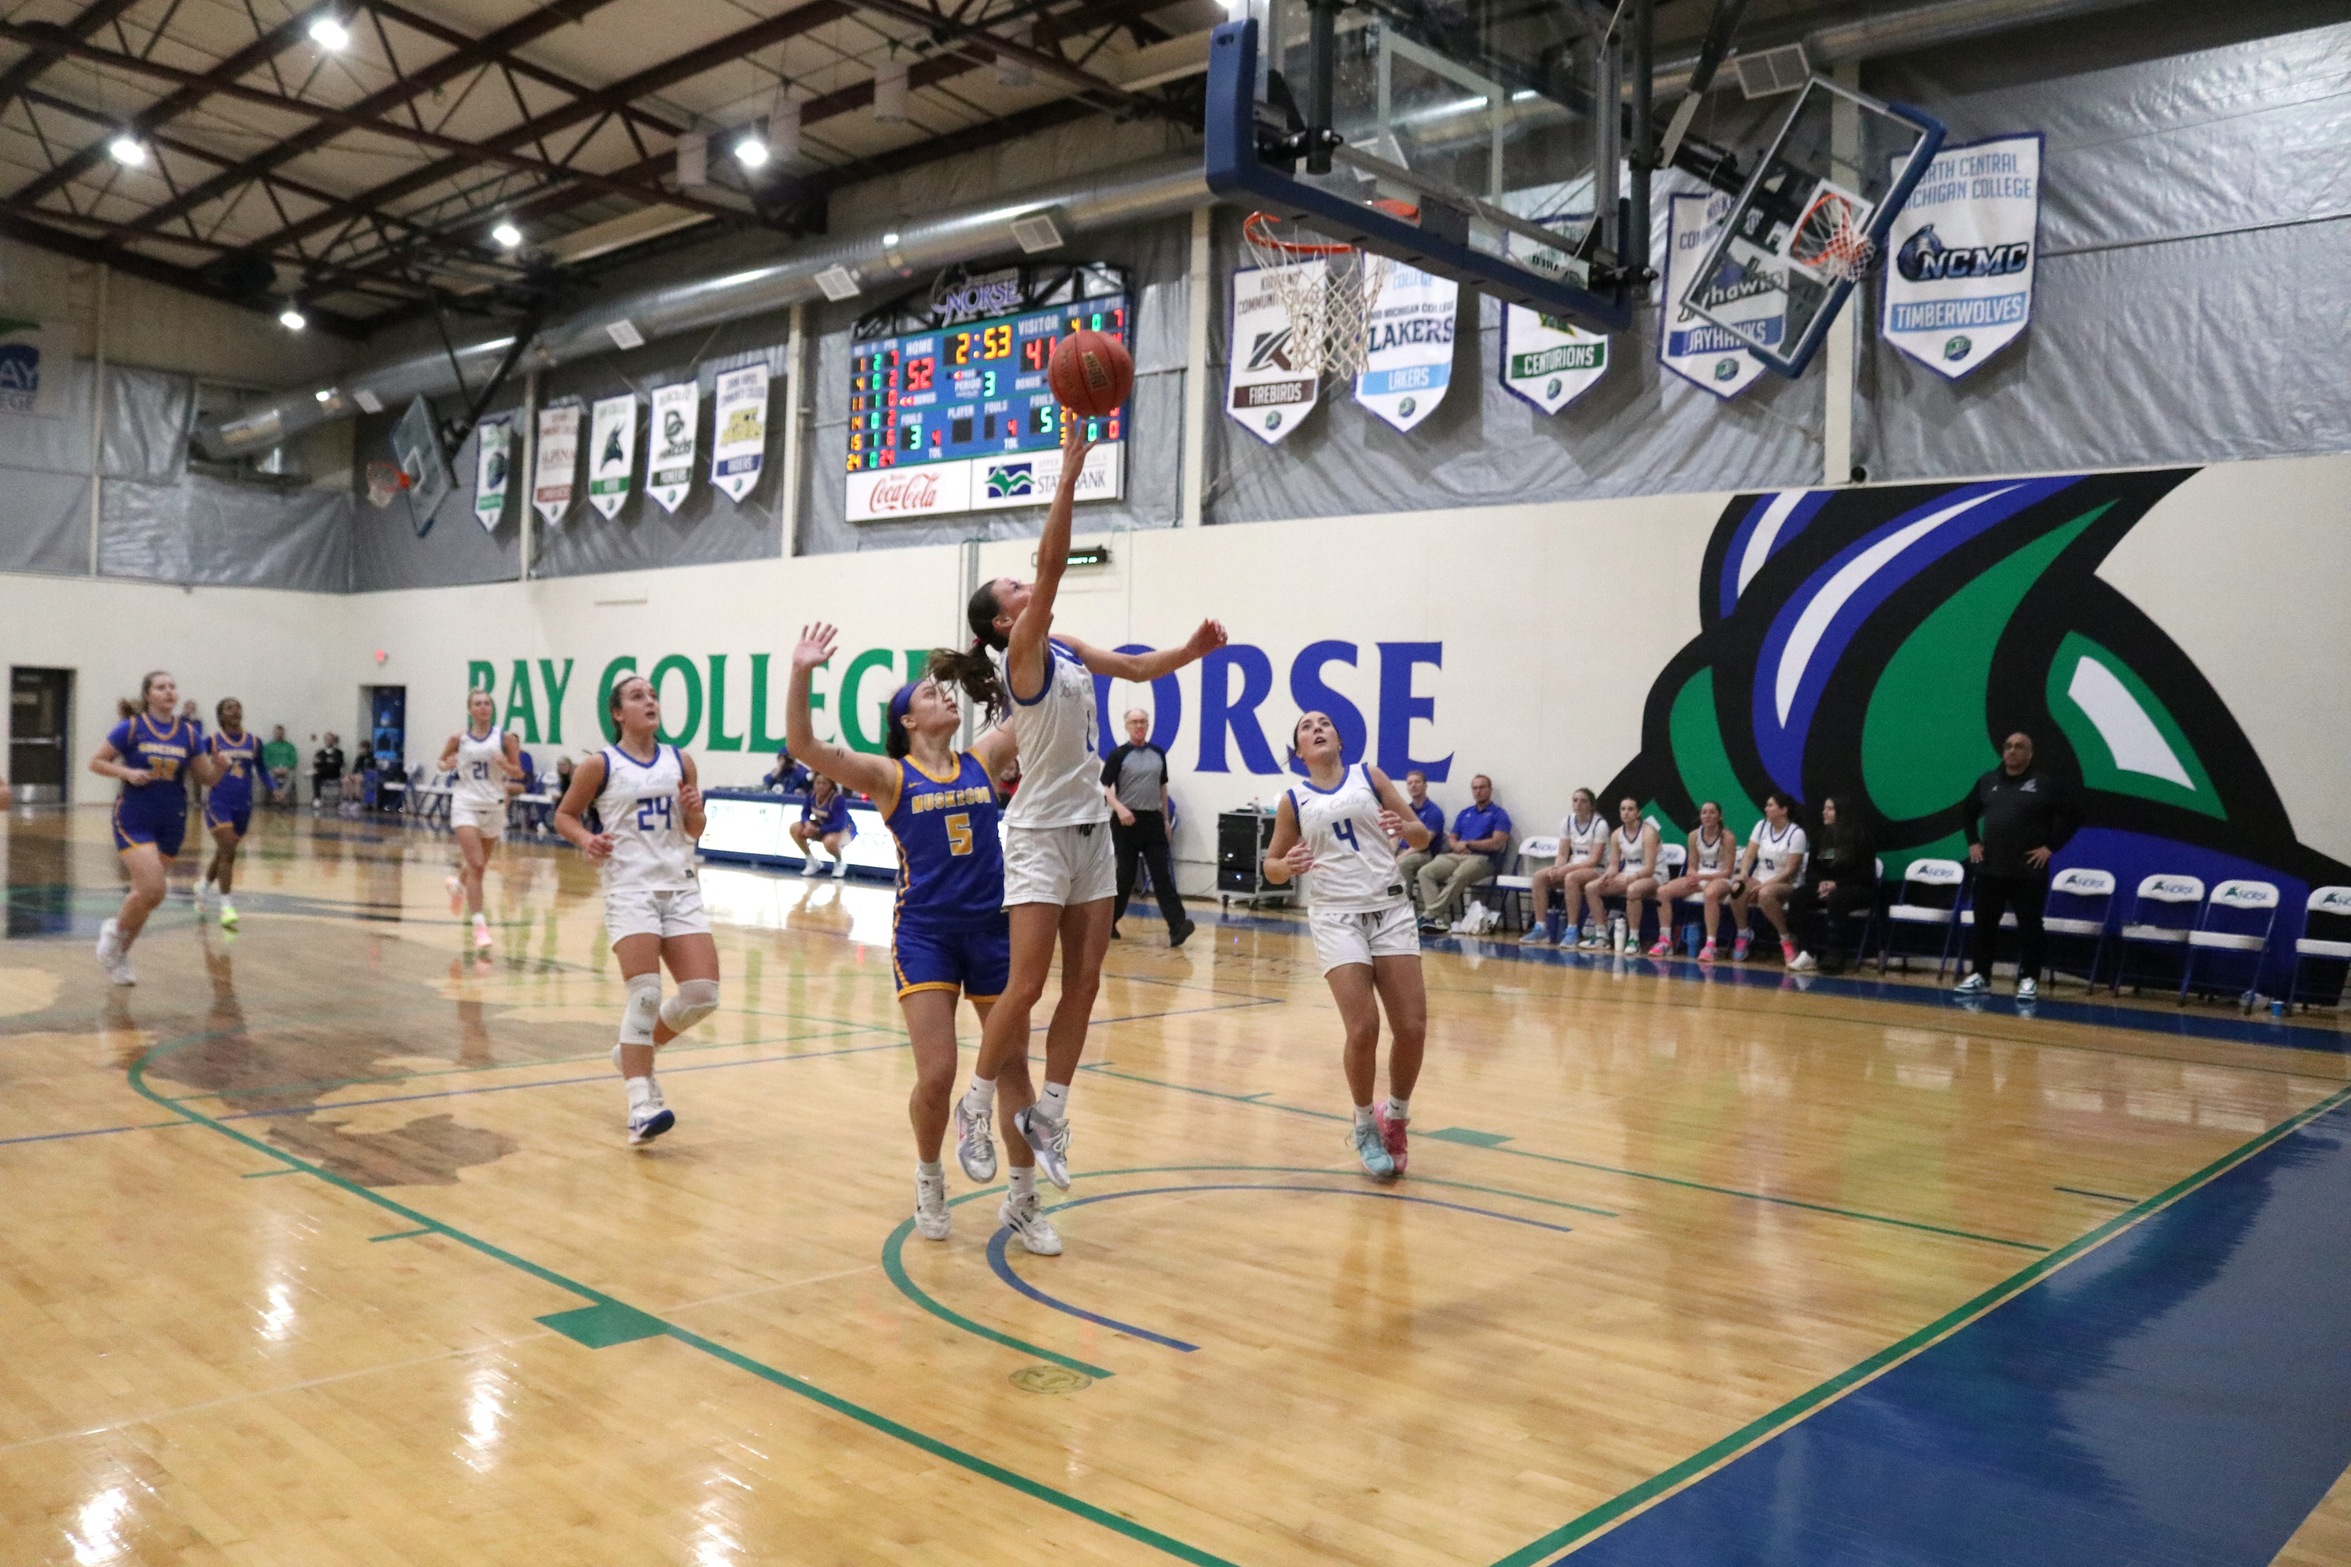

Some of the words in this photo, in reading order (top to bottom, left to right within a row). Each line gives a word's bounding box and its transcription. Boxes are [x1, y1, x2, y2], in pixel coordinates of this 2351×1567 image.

[1920, 160, 1955, 185] RTH
[1959, 153, 2020, 178] CENTRAL
[1972, 177, 2031, 200] COLLEGE
[1918, 241, 2030, 281] NCMC
[930, 278, 1024, 329] NORSE
[1896, 294, 2022, 329] TIMBERWOLVES
[1018, 314, 1059, 336] VISITOR
[1091, 313, 1102, 332] 0
[1368, 315, 1454, 353] LAKERS
[905, 337, 935, 357] HOME
[955, 324, 1013, 365] 2:53
[873, 353, 883, 371] 2
[907, 357, 935, 391] 52
[1523, 345, 1595, 376] CENTURIONS
[0, 359, 34, 391] AY
[983, 370, 997, 397] 3
[1387, 366, 1431, 391] LAKERS
[1029, 393, 1055, 408] FOULS
[1249, 382, 1303, 406] FIREBIRDS
[870, 411, 880, 430] 0
[947, 404, 975, 420] PLAYER
[984, 399, 1008, 415] FOULS
[1040, 405, 1054, 433] 5
[909, 424, 922, 450] 3
[1087, 422, 1098, 442] 0
[1108, 419, 1120, 440] 0
[467, 658, 574, 745] BAY
[597, 648, 930, 757] COLLEG
[1093, 638, 1454, 783] ORSE
[471, 761, 488, 780] 21
[636, 795, 672, 831] 24
[944, 812, 974, 856] 5
[1332, 817, 1360, 853] 4
